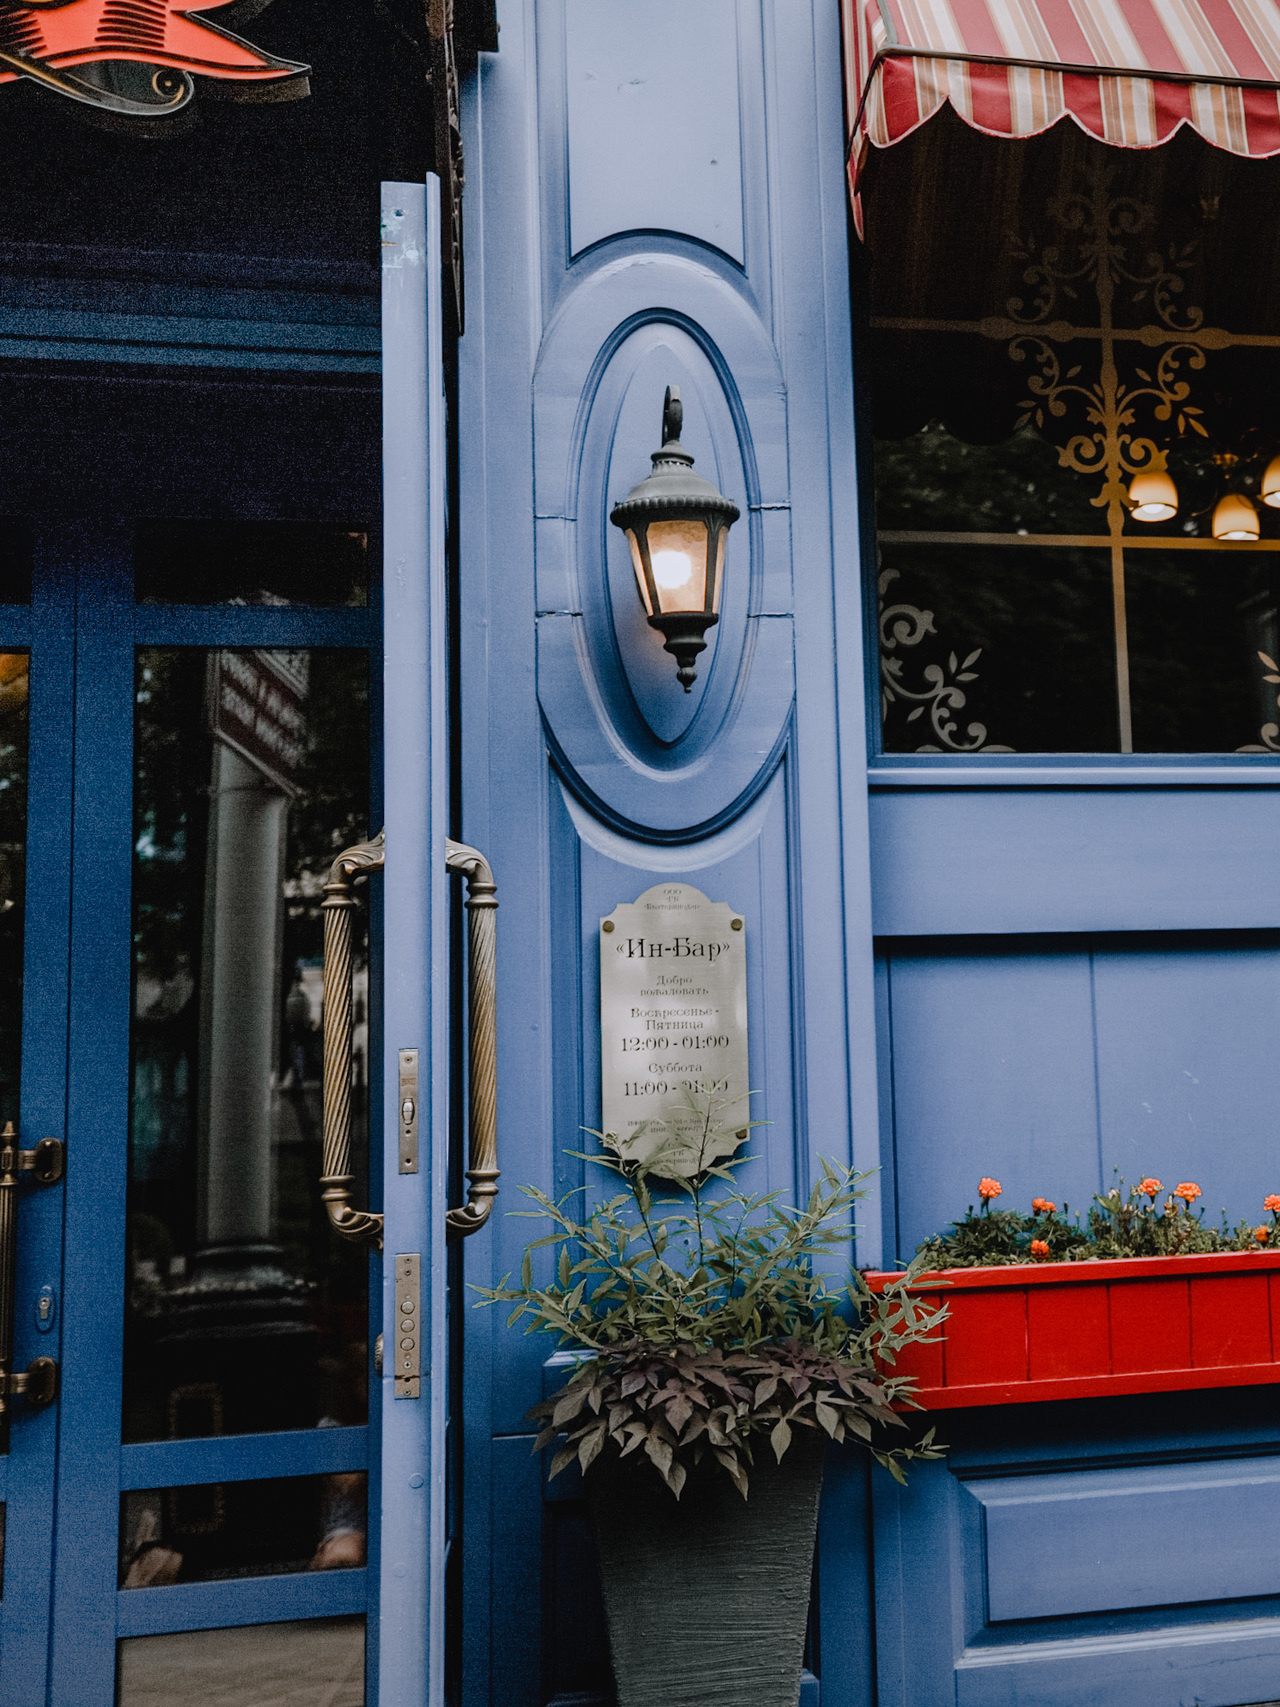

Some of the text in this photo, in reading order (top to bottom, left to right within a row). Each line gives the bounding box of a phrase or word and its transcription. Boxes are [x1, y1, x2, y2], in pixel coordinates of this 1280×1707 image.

[615, 936, 731, 962] «Ин-Бар»
[655, 974, 694, 987] Добро
[639, 986, 710, 997] пожаловать
[645, 1019, 704, 1031] Пятница
[621, 1036, 670, 1053] 12:00
[681, 1034, 730, 1050] 01:00
[648, 1061, 704, 1076] Суббота
[623, 1080, 669, 1097] 11:00
